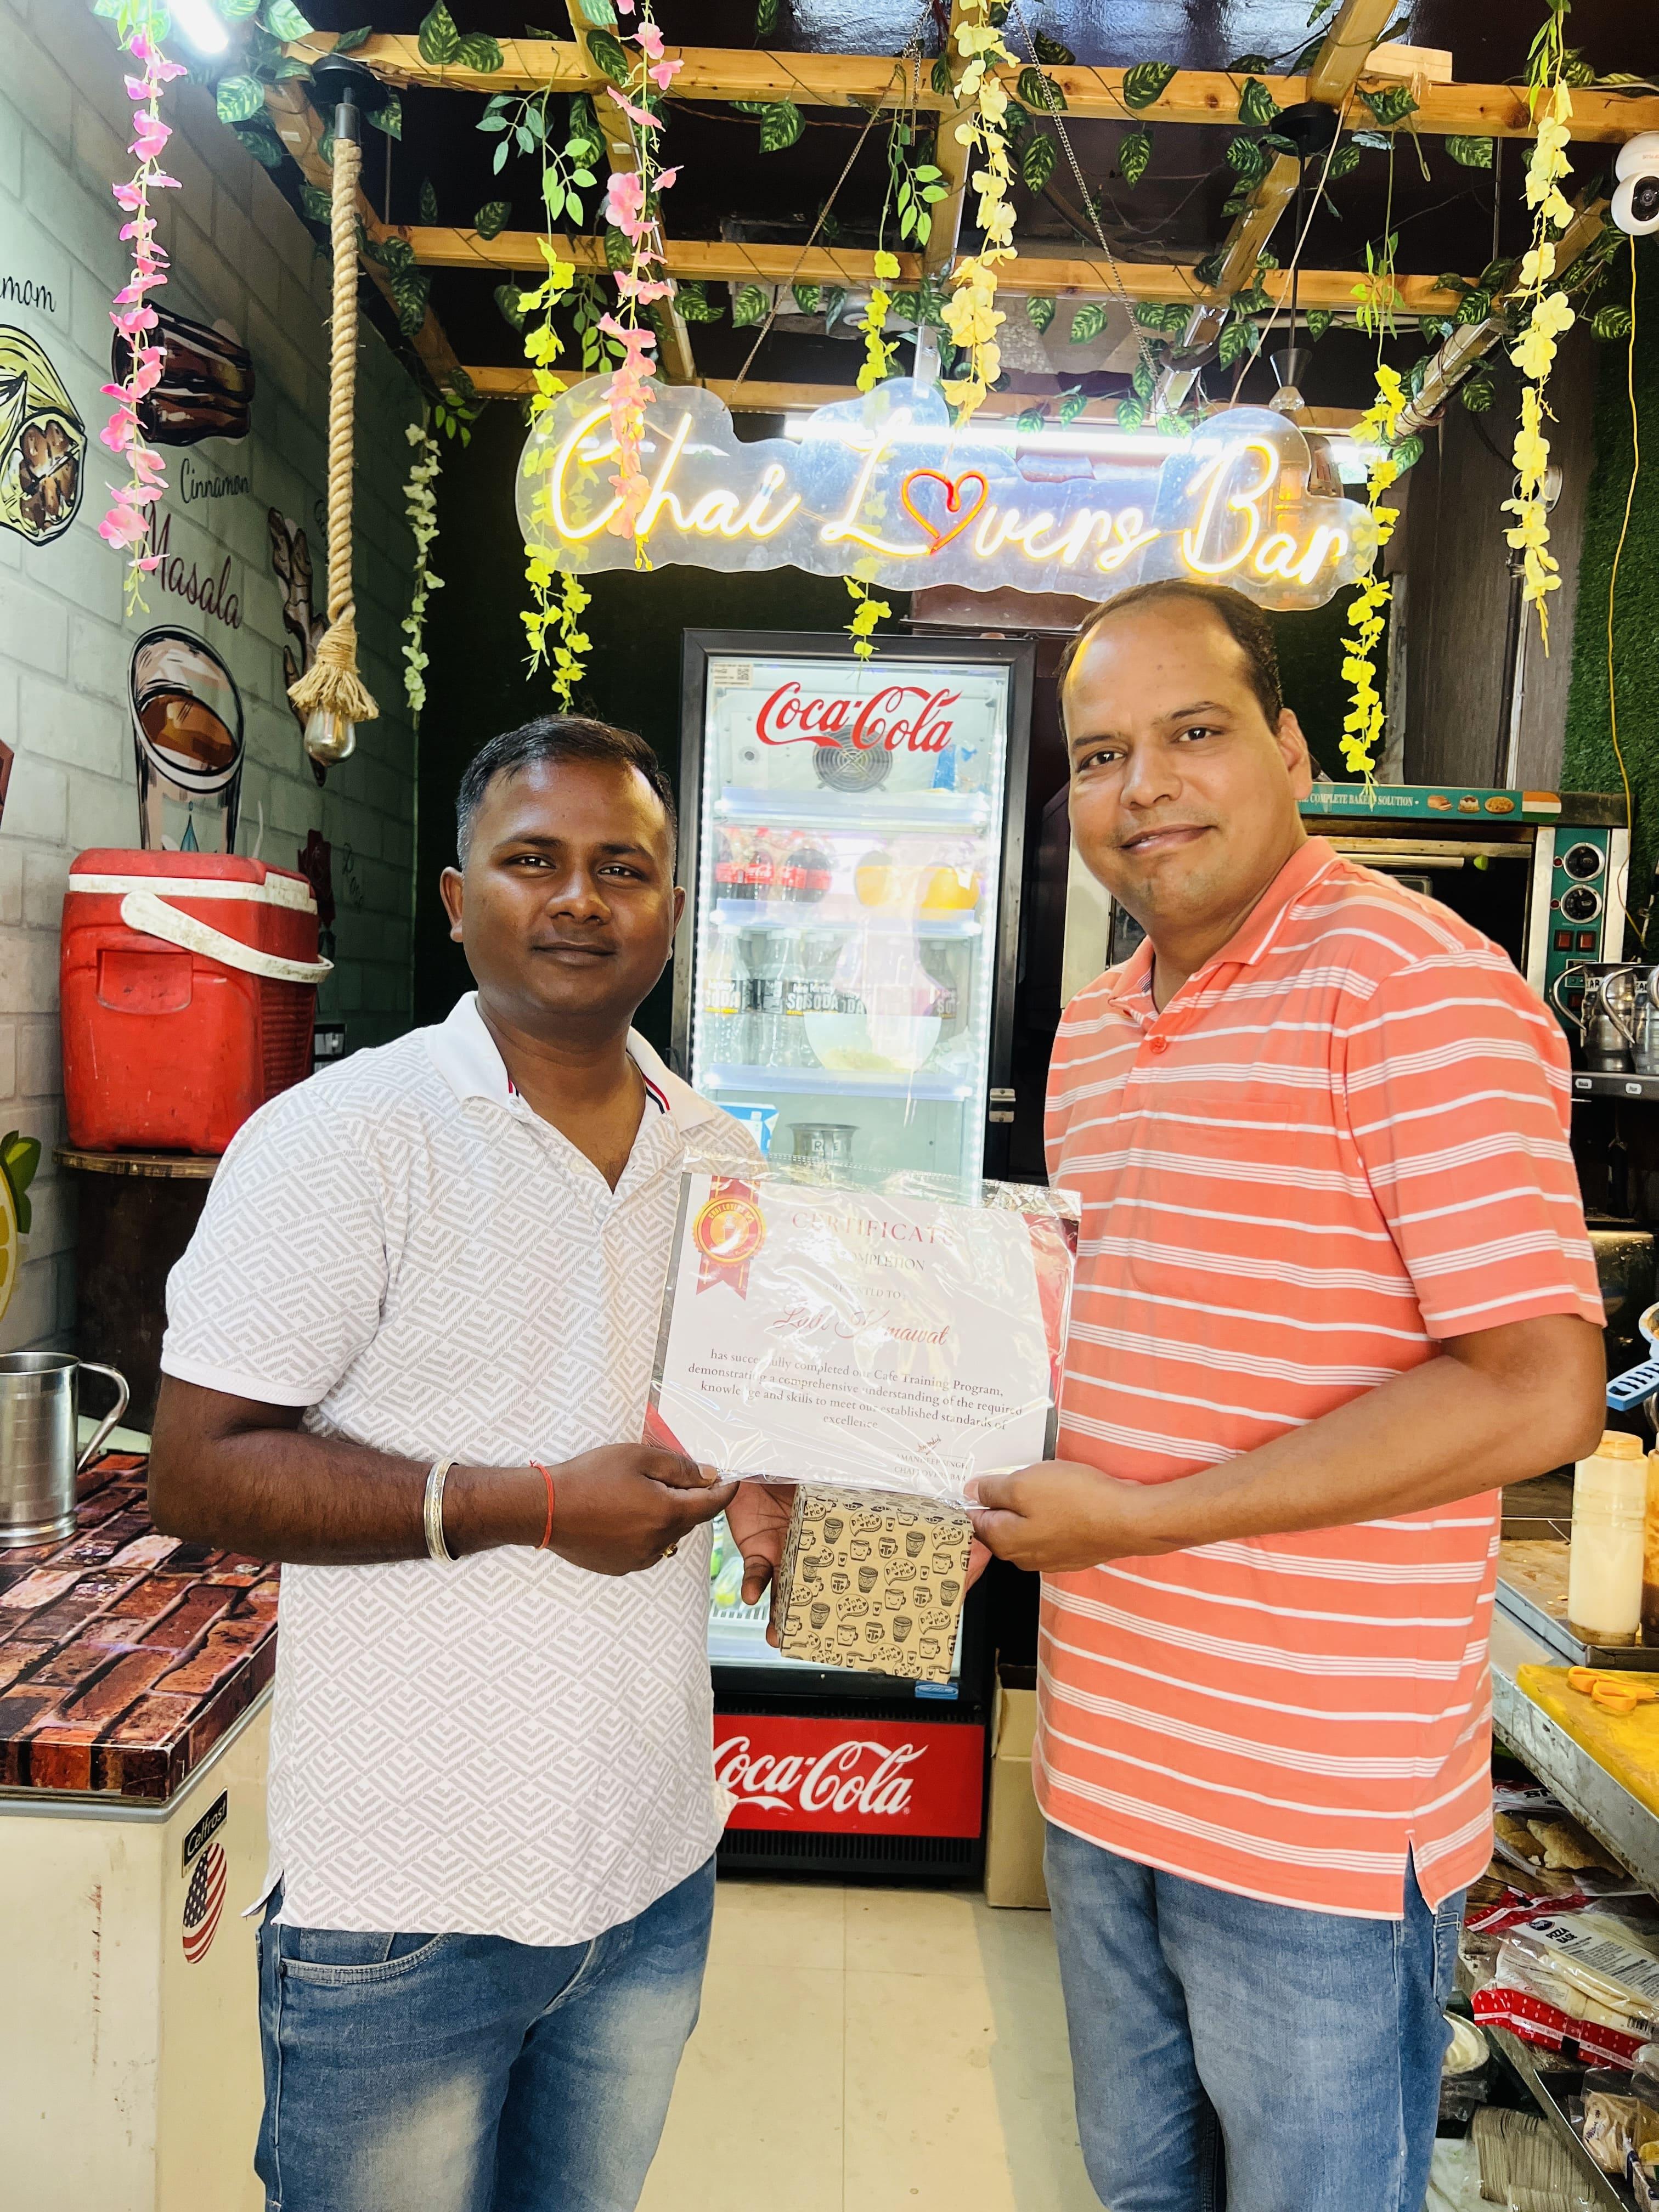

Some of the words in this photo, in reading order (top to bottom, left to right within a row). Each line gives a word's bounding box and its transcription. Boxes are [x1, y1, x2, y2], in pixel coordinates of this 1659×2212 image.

[552, 404, 802, 541] Chai
[1182, 438, 1348, 585] Bar
[137, 500, 241, 629] Masala
[756, 681, 963, 753] Coca-Cola
[1310, 793, 1347, 804] COMPLETE
[1378, 795, 1414, 806] SOLUTION
[704, 990, 741, 1009] SODA
[803, 994, 839, 1010] SODA
[793, 1211, 955, 1246] CERTIFICATE
[850, 1251, 925, 1271] OMPLETION
[710, 1349, 729, 1360] has
[794, 1362, 849, 1375] completed
[874, 1367, 898, 1381] Cafe
[903, 1373, 949, 1392] Training
[953, 1380, 1003, 1397] Program,
[764, 1390, 783, 1401] and
[787, 1392, 813, 1404] skills
[816, 1397, 826, 1406] to
[830, 1400, 856, 1410] meet
[881, 1406, 938, 1420] established
[941, 1413, 992, 1427] standards
[778, 1375, 859, 1393] comprehensive
[943, 1396, 955, 1405] of
[957, 1397, 978, 1409] the
[978, 1403, 1022, 1416] required
[823, 1413, 878, 1429] excellence
[899, 1567, 911, 1576] Me
[934, 1616, 945, 1624] Me
[713, 1735, 929, 1814] Coca-Cola
[187, 1799, 227, 1857] Celfrost
[1545, 1927, 1570, 1940] PIZZA
[1556, 1933, 1578, 1944] BASE
